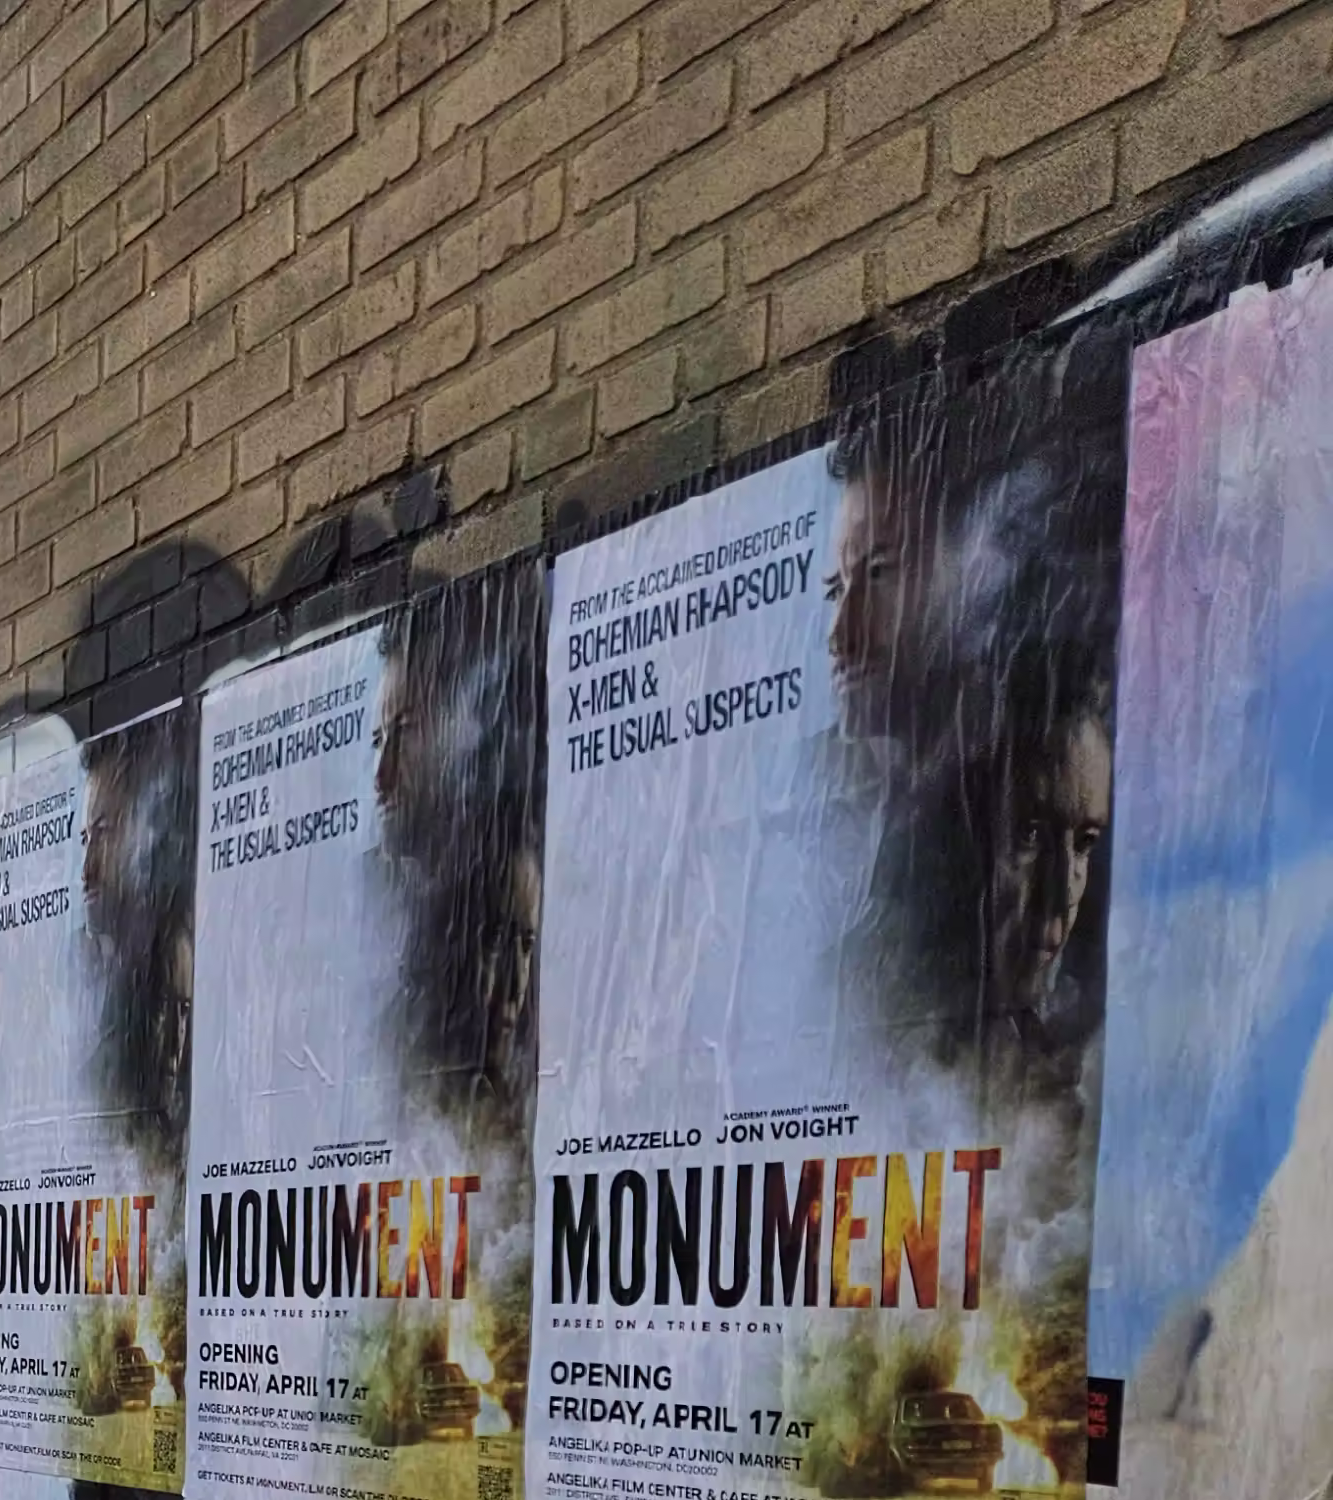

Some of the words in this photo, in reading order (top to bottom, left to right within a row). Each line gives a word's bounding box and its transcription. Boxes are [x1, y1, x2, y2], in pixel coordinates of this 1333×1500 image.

[570, 592, 607, 625] FROM
[611, 580, 635, 608] THE
[637, 550, 714, 599] ACCLAIMED
[717, 521, 791, 571] DIRECTOR
[795, 510, 817, 541] OF
[569, 597, 680, 672] BOHEMIAN
[685, 549, 814, 634] RHAPSODY
[568, 661, 636, 724] X-MEN
[641, 660, 659, 700] &
[568, 727, 605, 774] THE
[609, 707, 679, 763] USUAL
[684, 667, 802, 740] SUSPECTS
[213, 737, 283, 791] BOHEMIAN
[285, 708, 365, 765] RHAPSODY
[210, 839, 234, 873] THE
[237, 824, 281, 864] USUAL
[284, 799, 359, 851] SUSPECTS
[211, 790, 256, 832] X-MEN
[260, 786, 270, 816] &
[555, 1136, 594, 1156] JOE
[598, 1129, 702, 1153] MAZZELLO
[716, 1121, 764, 1146] JON
[770, 1116, 859, 1141] VOIGHT
[198, 1175, 481, 1300] MONUMENT
[551, 1147, 1002, 1311] MONUMENT
[199, 1343, 279, 1365] OPENING
[550, 1361, 673, 1392] OPENING
[199, 1370, 261, 1396] FRIDAY,
[266, 1374, 318, 1398] APRIL
[326, 1378, 350, 1400] 17
[549, 1396, 647, 1430] FRIDAY,
[652, 1404, 738, 1434] APRIL
[749, 1410, 783, 1437] 17
[785, 1421, 815, 1440] AT
[549, 1436, 610, 1455] ANGELIKA
[612, 1440, 664, 1459] POP-UP
[688, 1446, 735, 1465] UNION
[739, 1451, 803, 1471] MARKET
[547, 1472, 609, 1491] ANGELIKA
[611, 1476, 645, 1495] FILM
[649, 1481, 703, 1500] CENTER
[708, 1487, 717, 1500] &
